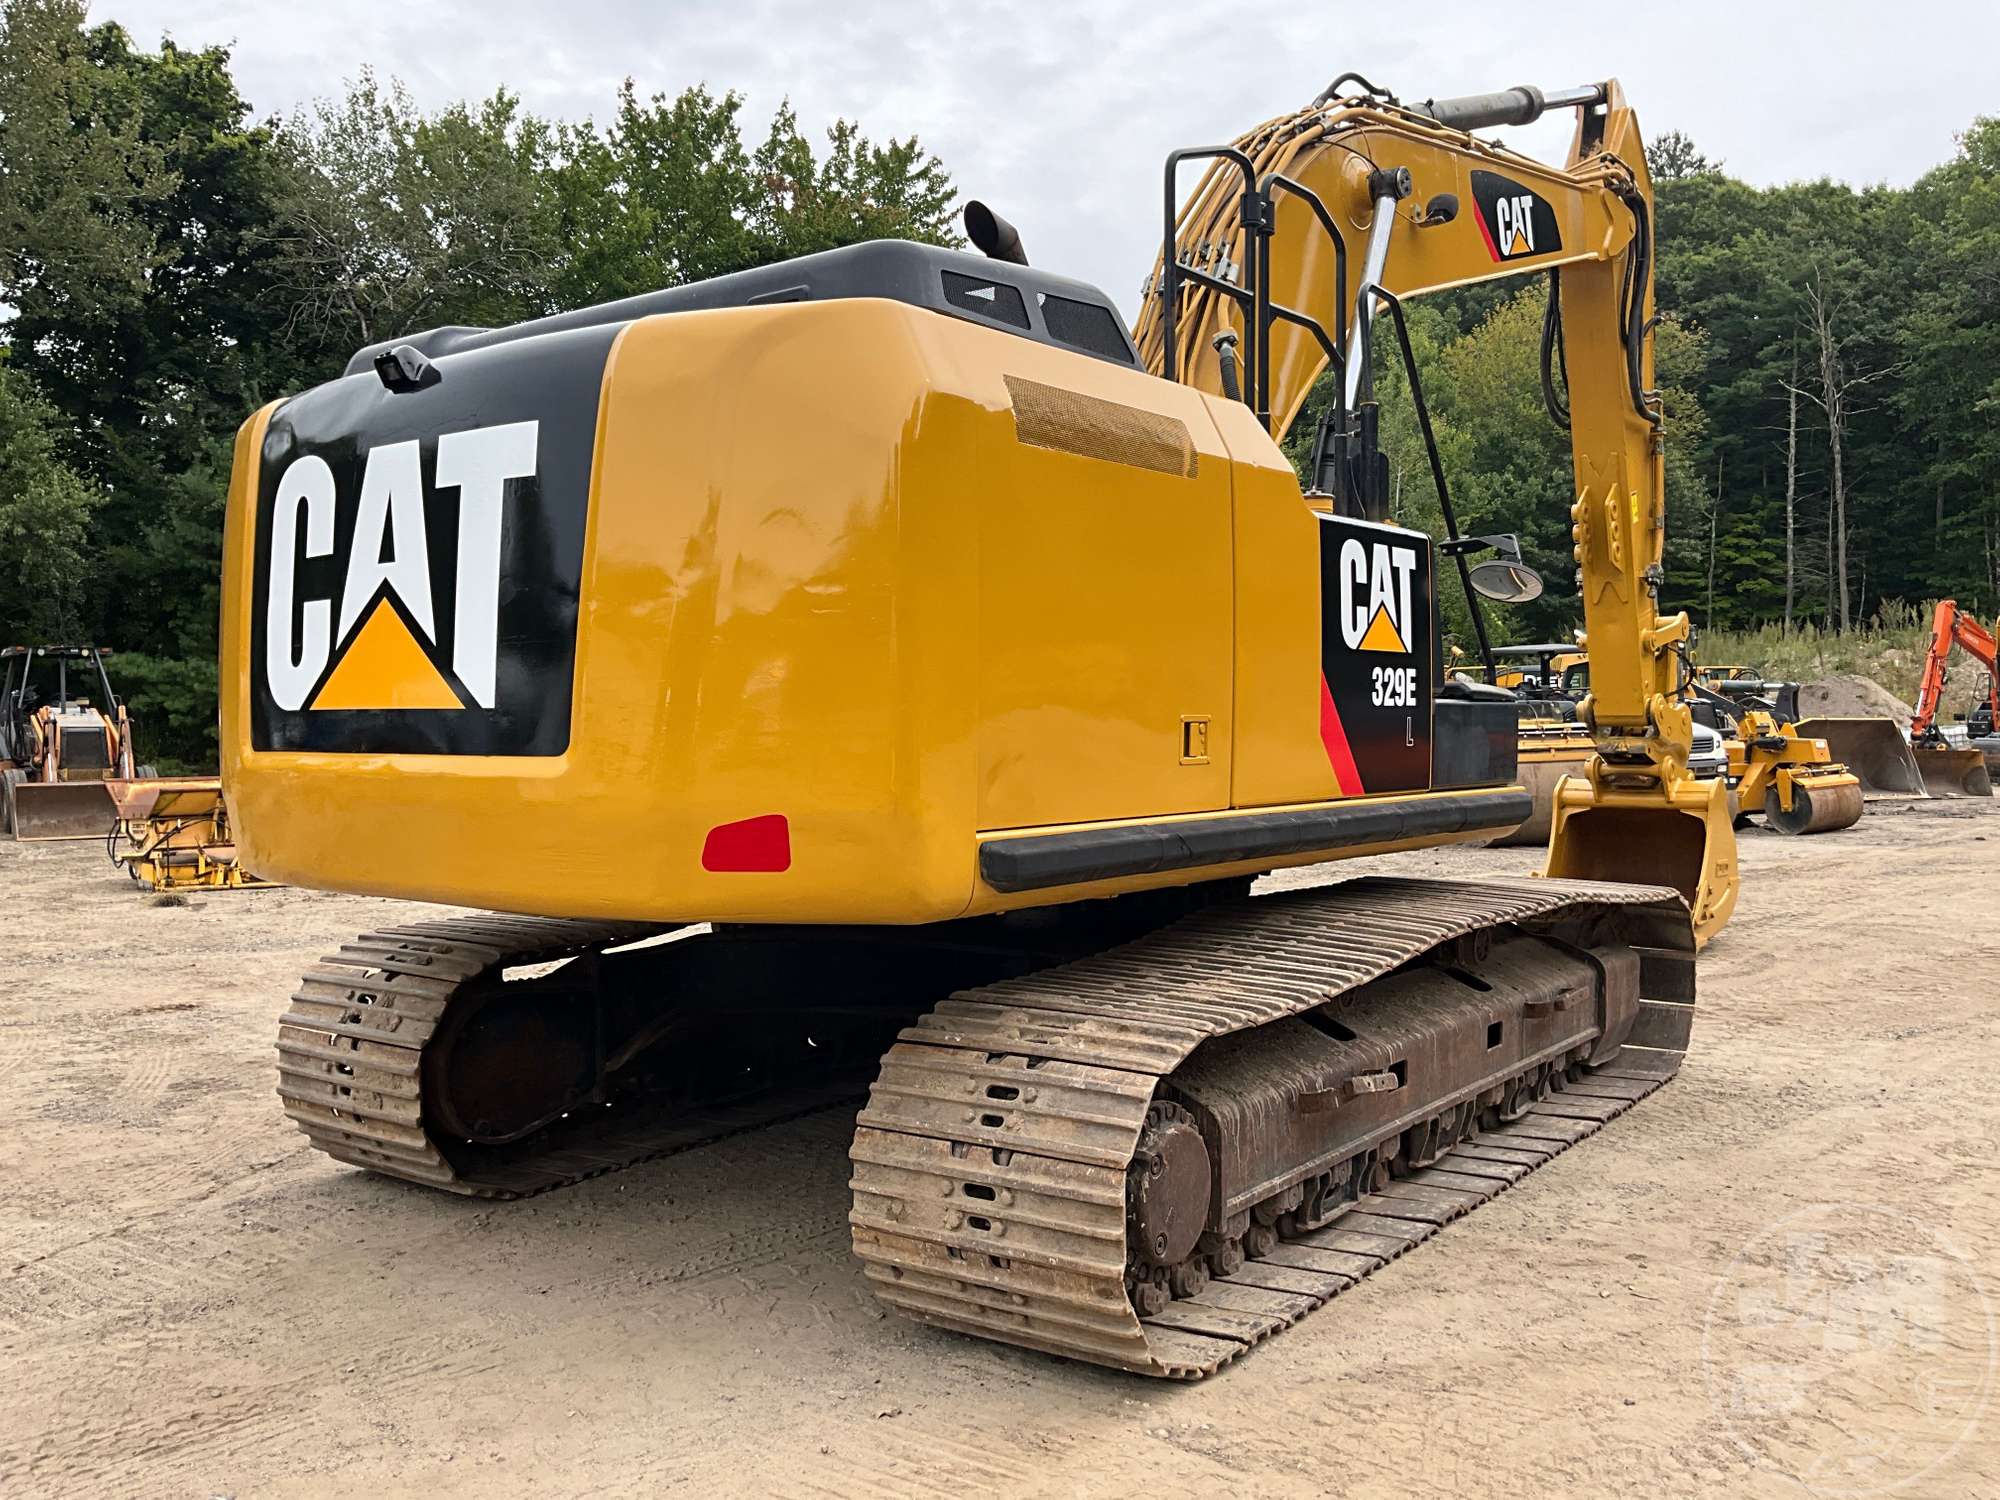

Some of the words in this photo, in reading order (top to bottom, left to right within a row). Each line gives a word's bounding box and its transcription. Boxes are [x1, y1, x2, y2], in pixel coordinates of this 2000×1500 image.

[1497, 195, 1536, 255] CAT
[266, 420, 540, 712] CAT
[1340, 538, 1417, 654] CAT
[1371, 667, 1417, 707] 329E
[1524, 674, 1580, 688] DEE
[1406, 716, 1415, 747] L
